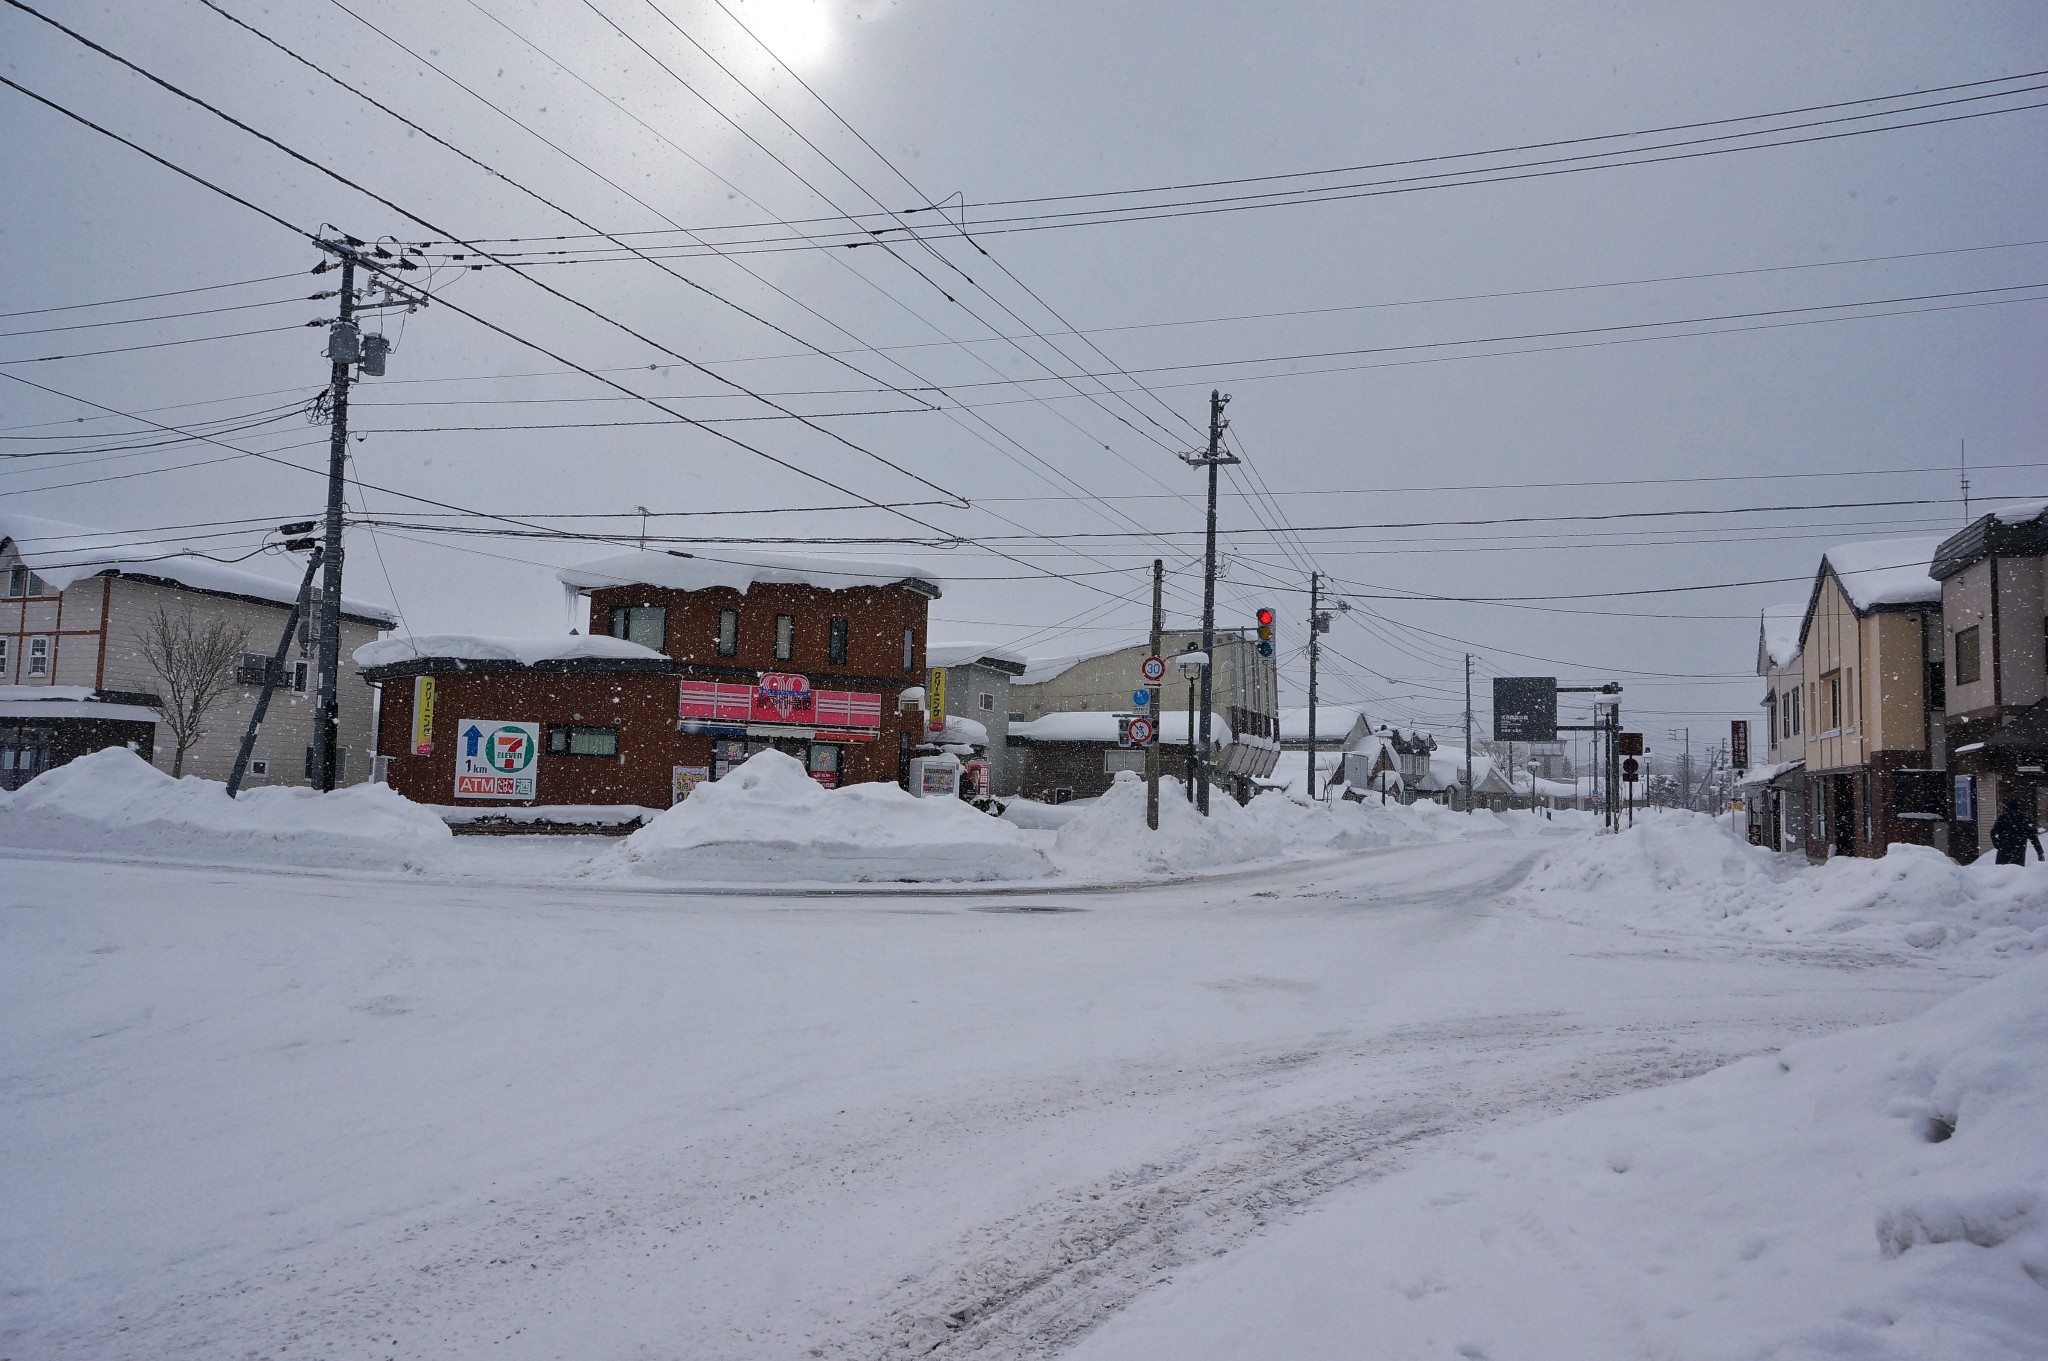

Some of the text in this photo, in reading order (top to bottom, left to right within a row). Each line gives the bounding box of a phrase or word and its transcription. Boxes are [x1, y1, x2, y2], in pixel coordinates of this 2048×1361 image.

[1147, 663, 1160, 674] 30
[933, 671, 941, 716] クリーニング
[460, 778, 494, 793] ATM
[516, 779, 532, 795] 酒
